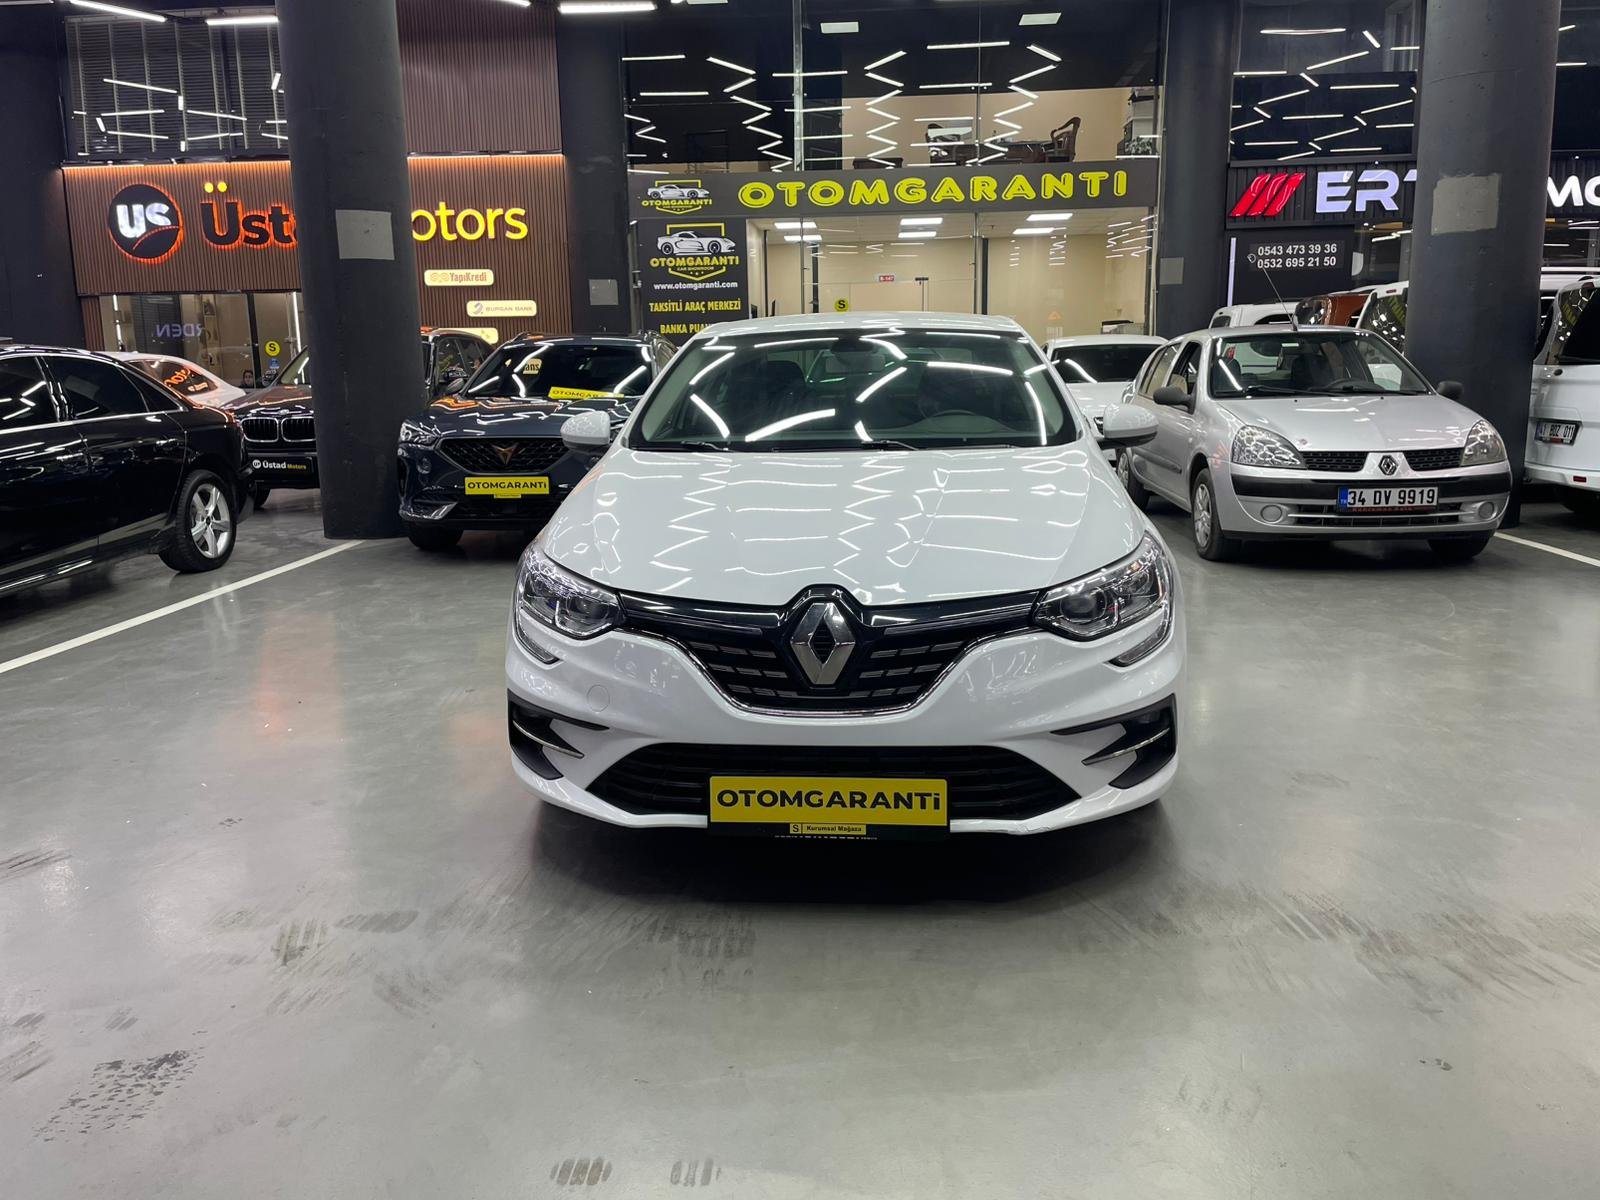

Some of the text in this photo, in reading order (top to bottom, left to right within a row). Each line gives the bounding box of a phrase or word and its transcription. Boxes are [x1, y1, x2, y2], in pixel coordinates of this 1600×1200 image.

[738, 170, 1127, 208] OTOMGARANTI
[200, 181, 297, 246] Üst
[411, 201, 529, 241] otors
[1257, 243, 1337, 256] 0543 473 39 36
[650, 256, 739, 267] OTOMGARANTI
[1257, 257, 1337, 269] 0532 695 21 50
[653, 281, 738, 290] www.otomgaranti.com
[649, 298, 741, 313] TAKSİTLİ ARAÇ MERKEZİ
[660, 324, 688, 334] BANKA
[262, 460, 287, 469] Üstad
[1348, 490, 1366, 505] 34
[1373, 490, 1392, 505] DV
[1398, 488, 1435, 504] 9919
[837, 825, 862, 833] Mağaza
